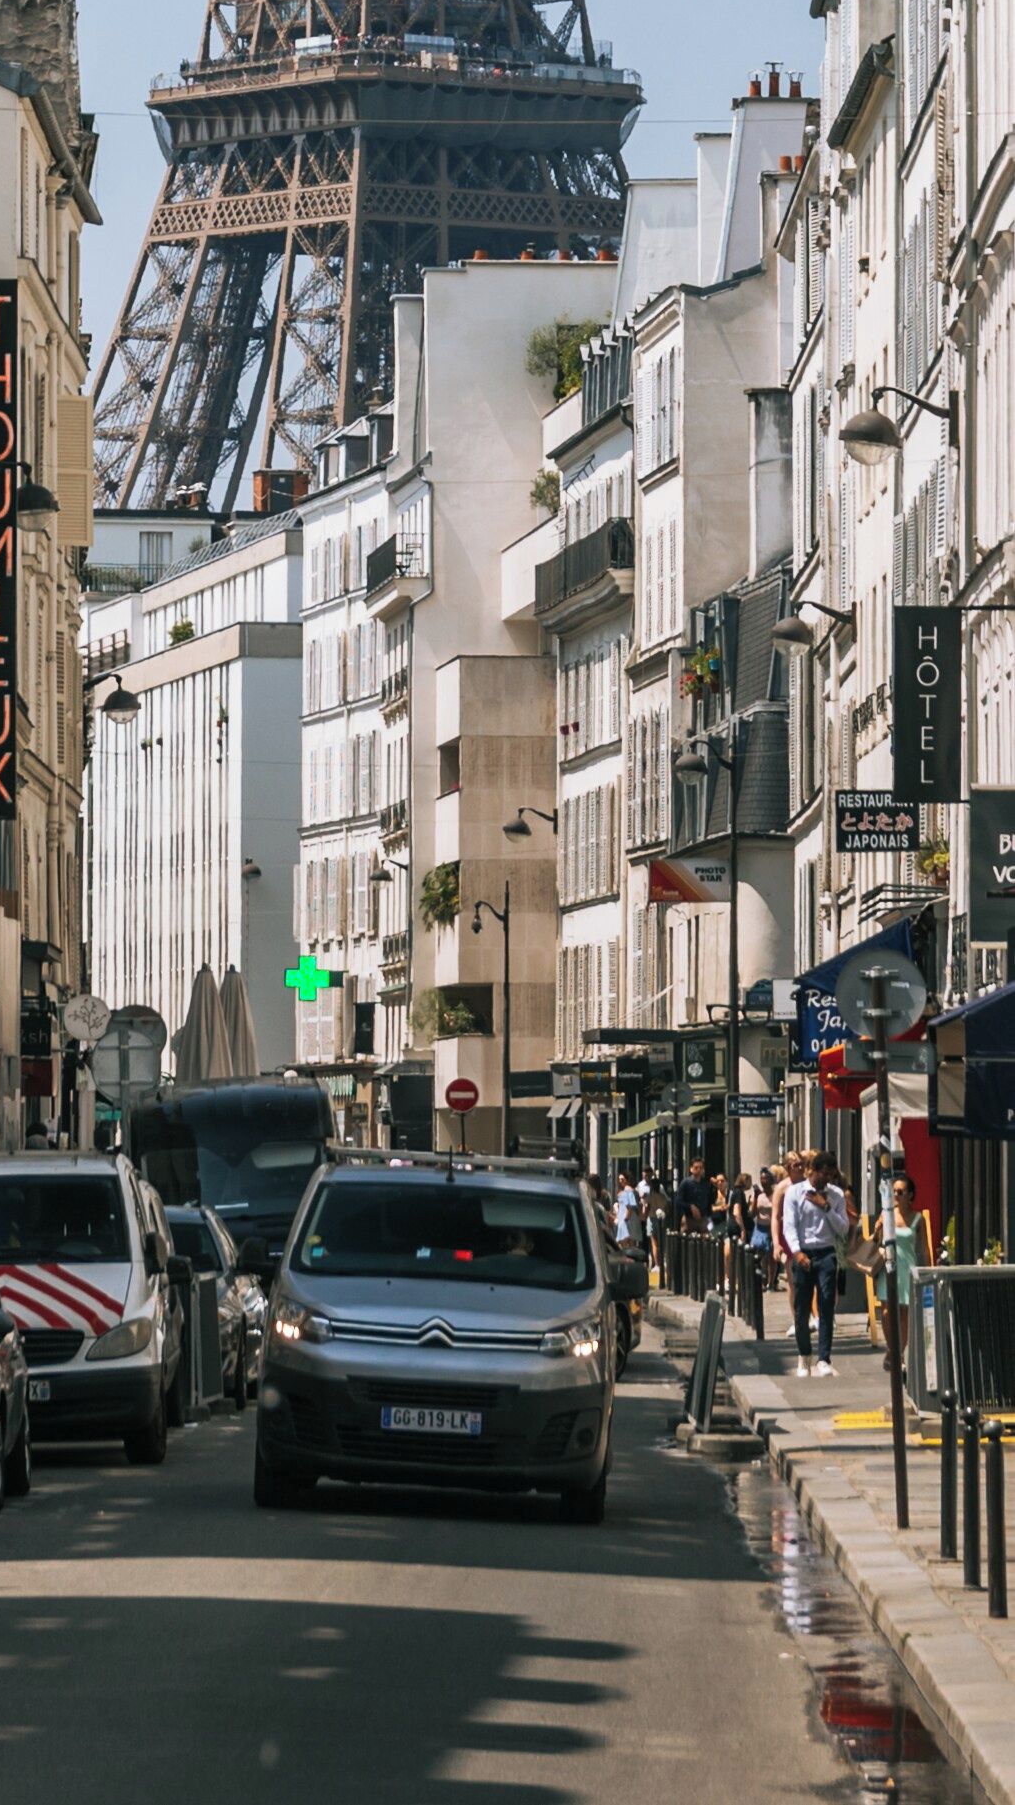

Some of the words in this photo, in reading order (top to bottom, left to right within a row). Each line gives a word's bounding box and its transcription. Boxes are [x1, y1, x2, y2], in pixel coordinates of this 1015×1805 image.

[916, 625, 940, 784] HÔTEL
[838, 794, 914, 808] RESTAUR
[841, 812, 914, 831] とよたか
[845, 834, 909, 848] JAPONAIS
